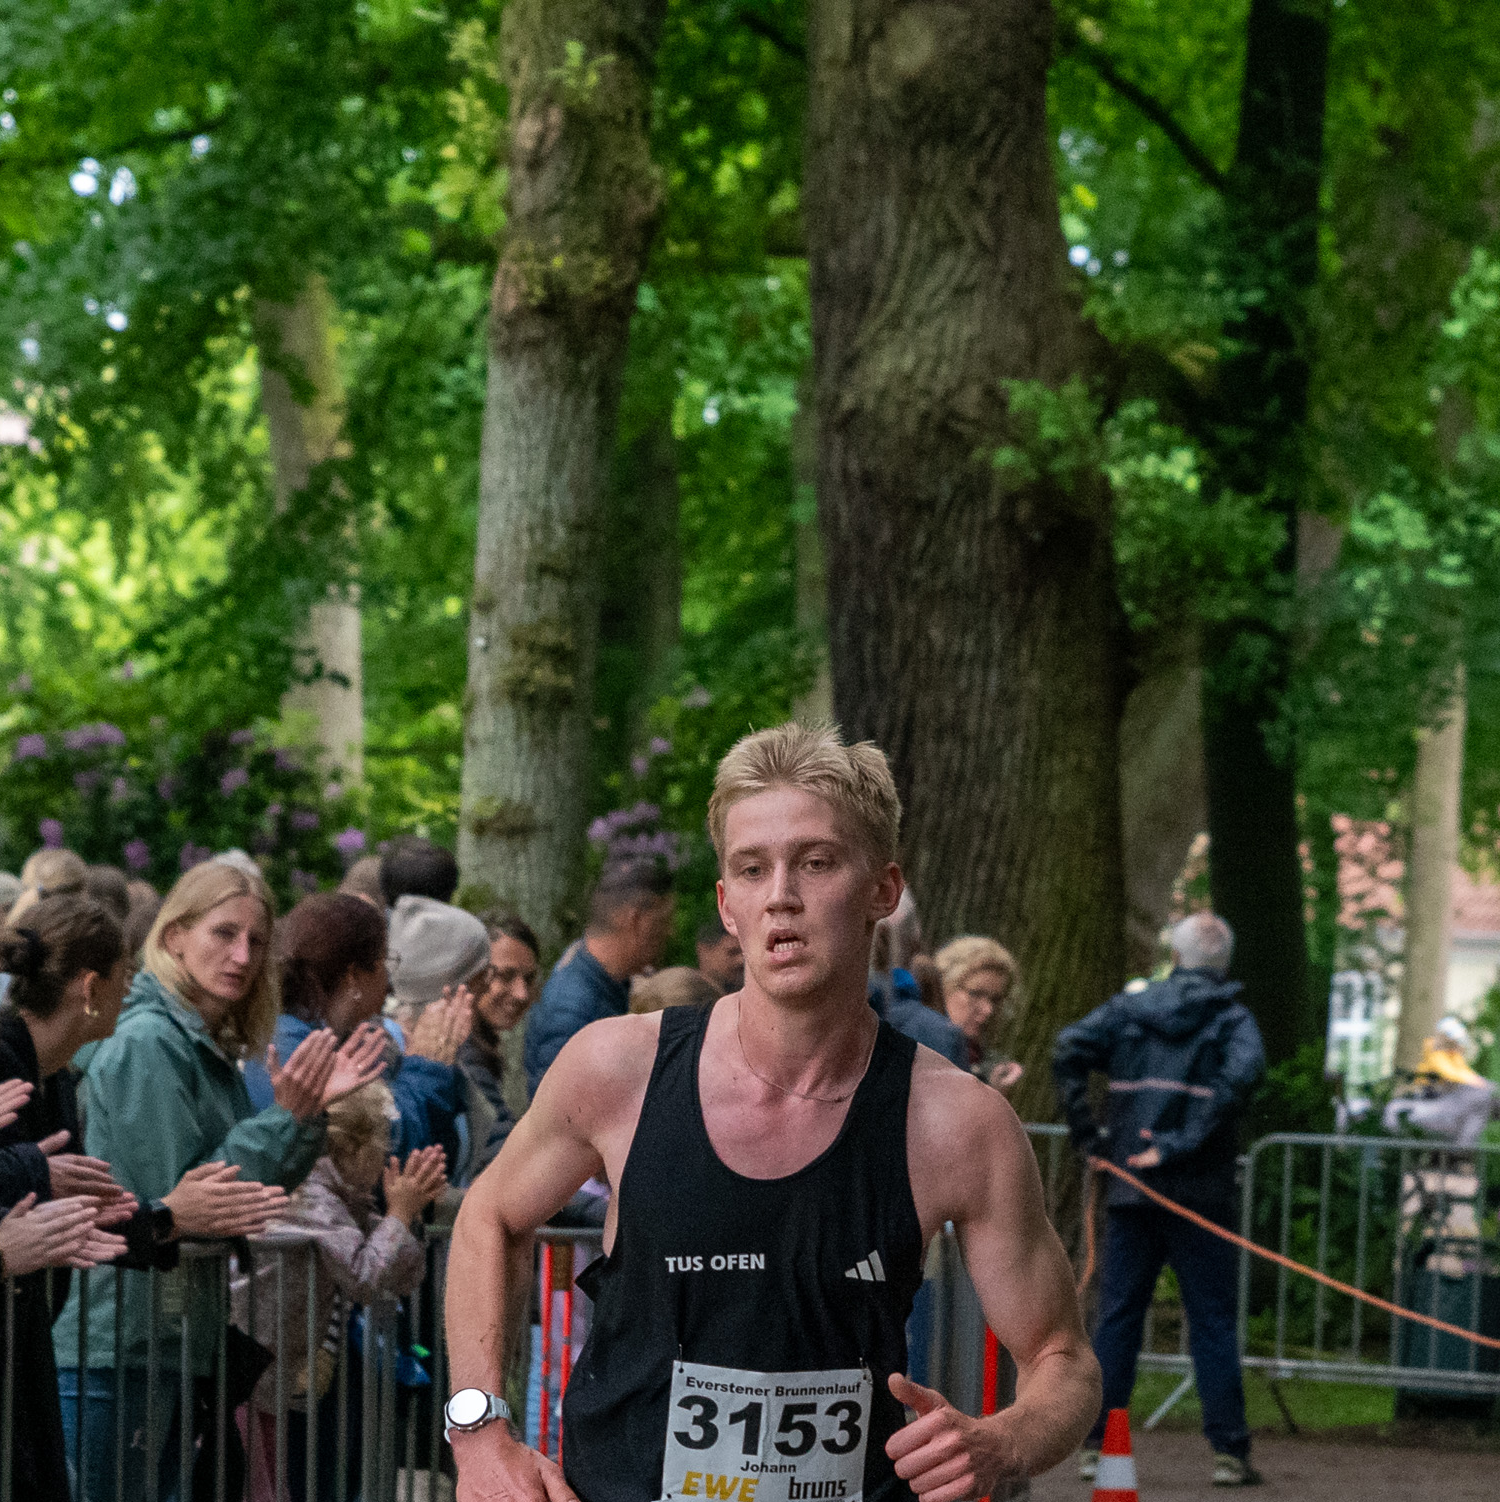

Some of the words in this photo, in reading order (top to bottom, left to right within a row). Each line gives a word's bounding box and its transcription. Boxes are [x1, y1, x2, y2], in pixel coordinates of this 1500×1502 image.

[665, 1256, 704, 1273] TUS
[710, 1253, 765, 1270] OFEN
[686, 1376, 770, 1397] Everstener
[775, 1382, 862, 1397] Brunnenlauf
[673, 1395, 863, 1457] 3153
[740, 1461, 797, 1473] Johann
[681, 1471, 759, 1502] EWE
[788, 1476, 847, 1500] bruns
